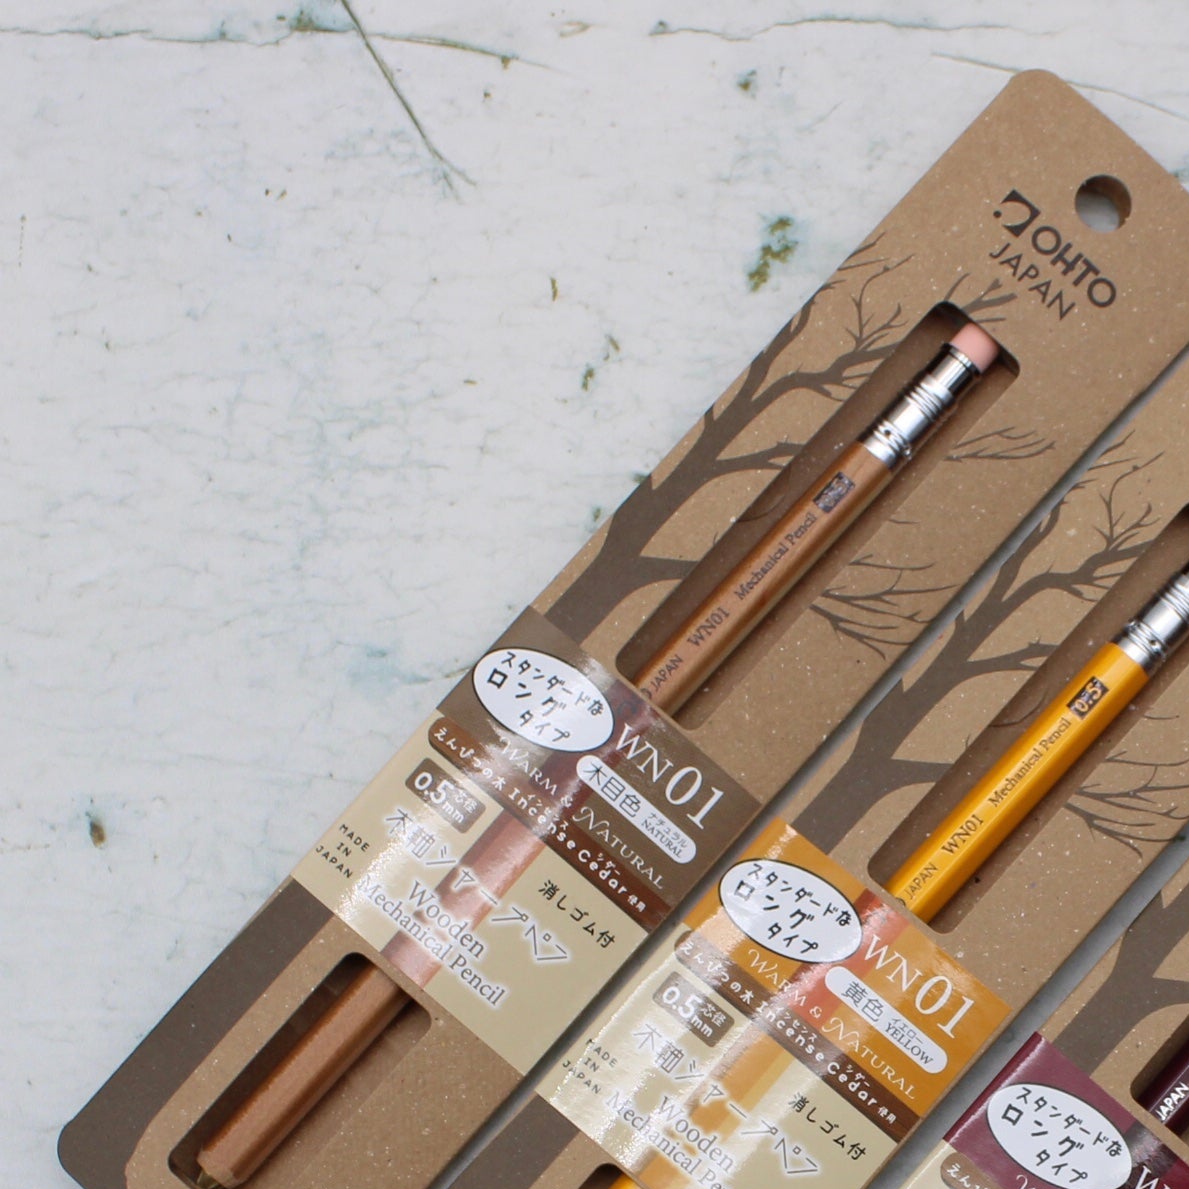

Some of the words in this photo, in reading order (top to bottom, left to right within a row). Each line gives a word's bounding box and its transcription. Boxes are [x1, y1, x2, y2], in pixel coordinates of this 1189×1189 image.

[988, 242, 1076, 321] JAPAN
[1030, 224, 1117, 308] OHTO
[648, 652, 685, 692] JAPAN
[686, 604, 731, 648] WN01
[732, 540, 791, 601] Mechanical
[783, 510, 819, 546] Pencil
[485, 668, 569, 716] ロング
[497, 652, 603, 715] スタンダードな
[517, 710, 570, 742] タイプ
[497, 737, 560, 796] WARM
[570, 808, 663, 889] NATURAL
[580, 759, 645, 818] 木目色
[639, 818, 685, 859] NATURAL
[614, 723, 727, 827] WN01
[902, 860, 939, 900] JAPAN
[939, 811, 986, 856] WN01
[986, 746, 1044, 808] Mechanical
[1037, 715, 1073, 751] Pencil
[314, 843, 354, 880] JAPAN
[334, 840, 353, 858] IN
[337, 822, 371, 854] MADE
[506, 786, 578, 850] Incense
[578, 850, 627, 893] Cedar
[383, 808, 567, 960] 木軸シャープペン
[408, 880, 485, 960] Wooden
[537, 879, 617, 947] 消しゴム付
[731, 880, 815, 929] ロング
[746, 863, 851, 926] スタンダードな
[355, 873, 452, 961] Mechanical
[447, 952, 505, 1006] Pencil
[766, 922, 819, 953] タイプ
[747, 949, 809, 1008] WARM
[822, 1019, 912, 1098] NATURAL
[840, 979, 888, 1023] 黄色
[882, 1021, 934, 1067] YELLOW
[863, 932, 973, 1036] WN01
[582, 1056, 601, 1074] IN
[754, 999, 826, 1063] Incense
[828, 1062, 876, 1105] Cedar
[603, 1088, 702, 1176] Mechanical
[632, 1022, 816, 1173] 木軸シャープペン
[657, 1094, 735, 1174] Wooden
[787, 1092, 866, 1159] 消しゴム付
[1000, 1103, 1085, 1157] ロング
[1015, 1086, 1121, 1156] スタンダードな
[1035, 1149, 1087, 1182] タイプ
